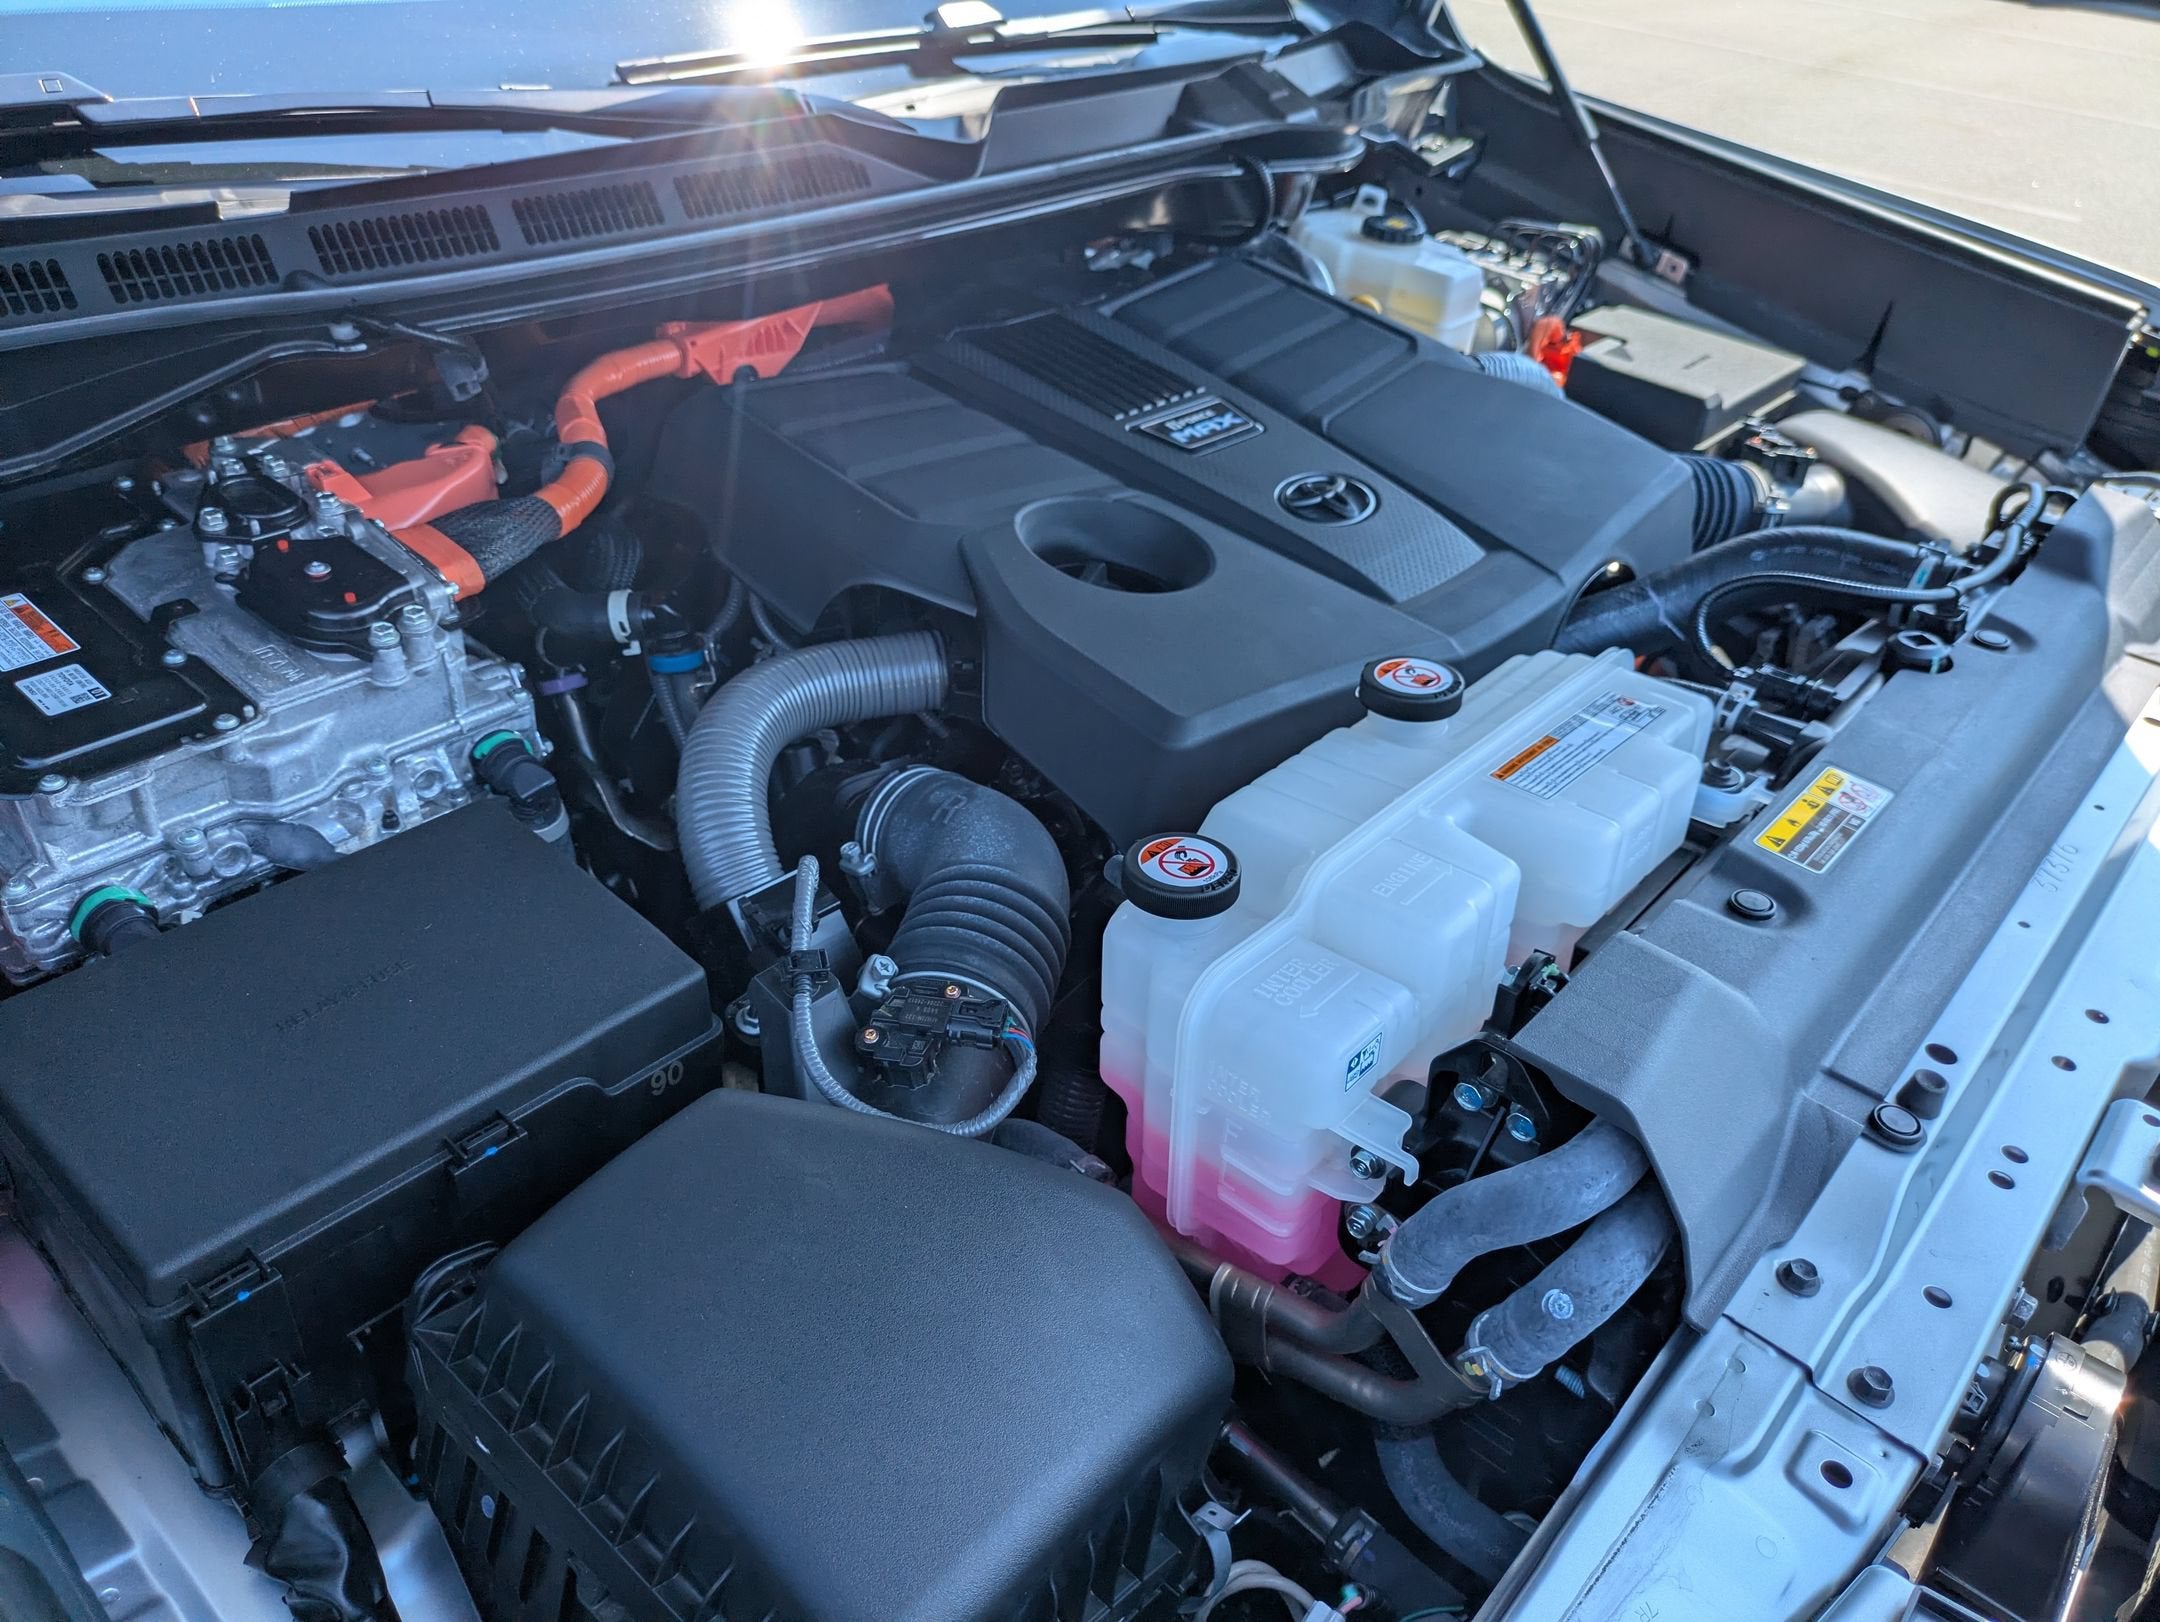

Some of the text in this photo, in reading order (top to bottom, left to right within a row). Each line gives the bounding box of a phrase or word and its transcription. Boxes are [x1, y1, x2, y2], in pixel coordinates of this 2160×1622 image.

[1169, 411, 1244, 443] MAX
[1371, 853, 1434, 898] ENGINE
[1253, 958, 1313, 999] INTER
[1273, 958, 1341, 1007] COOLER
[651, 1060, 684, 1096] 90
